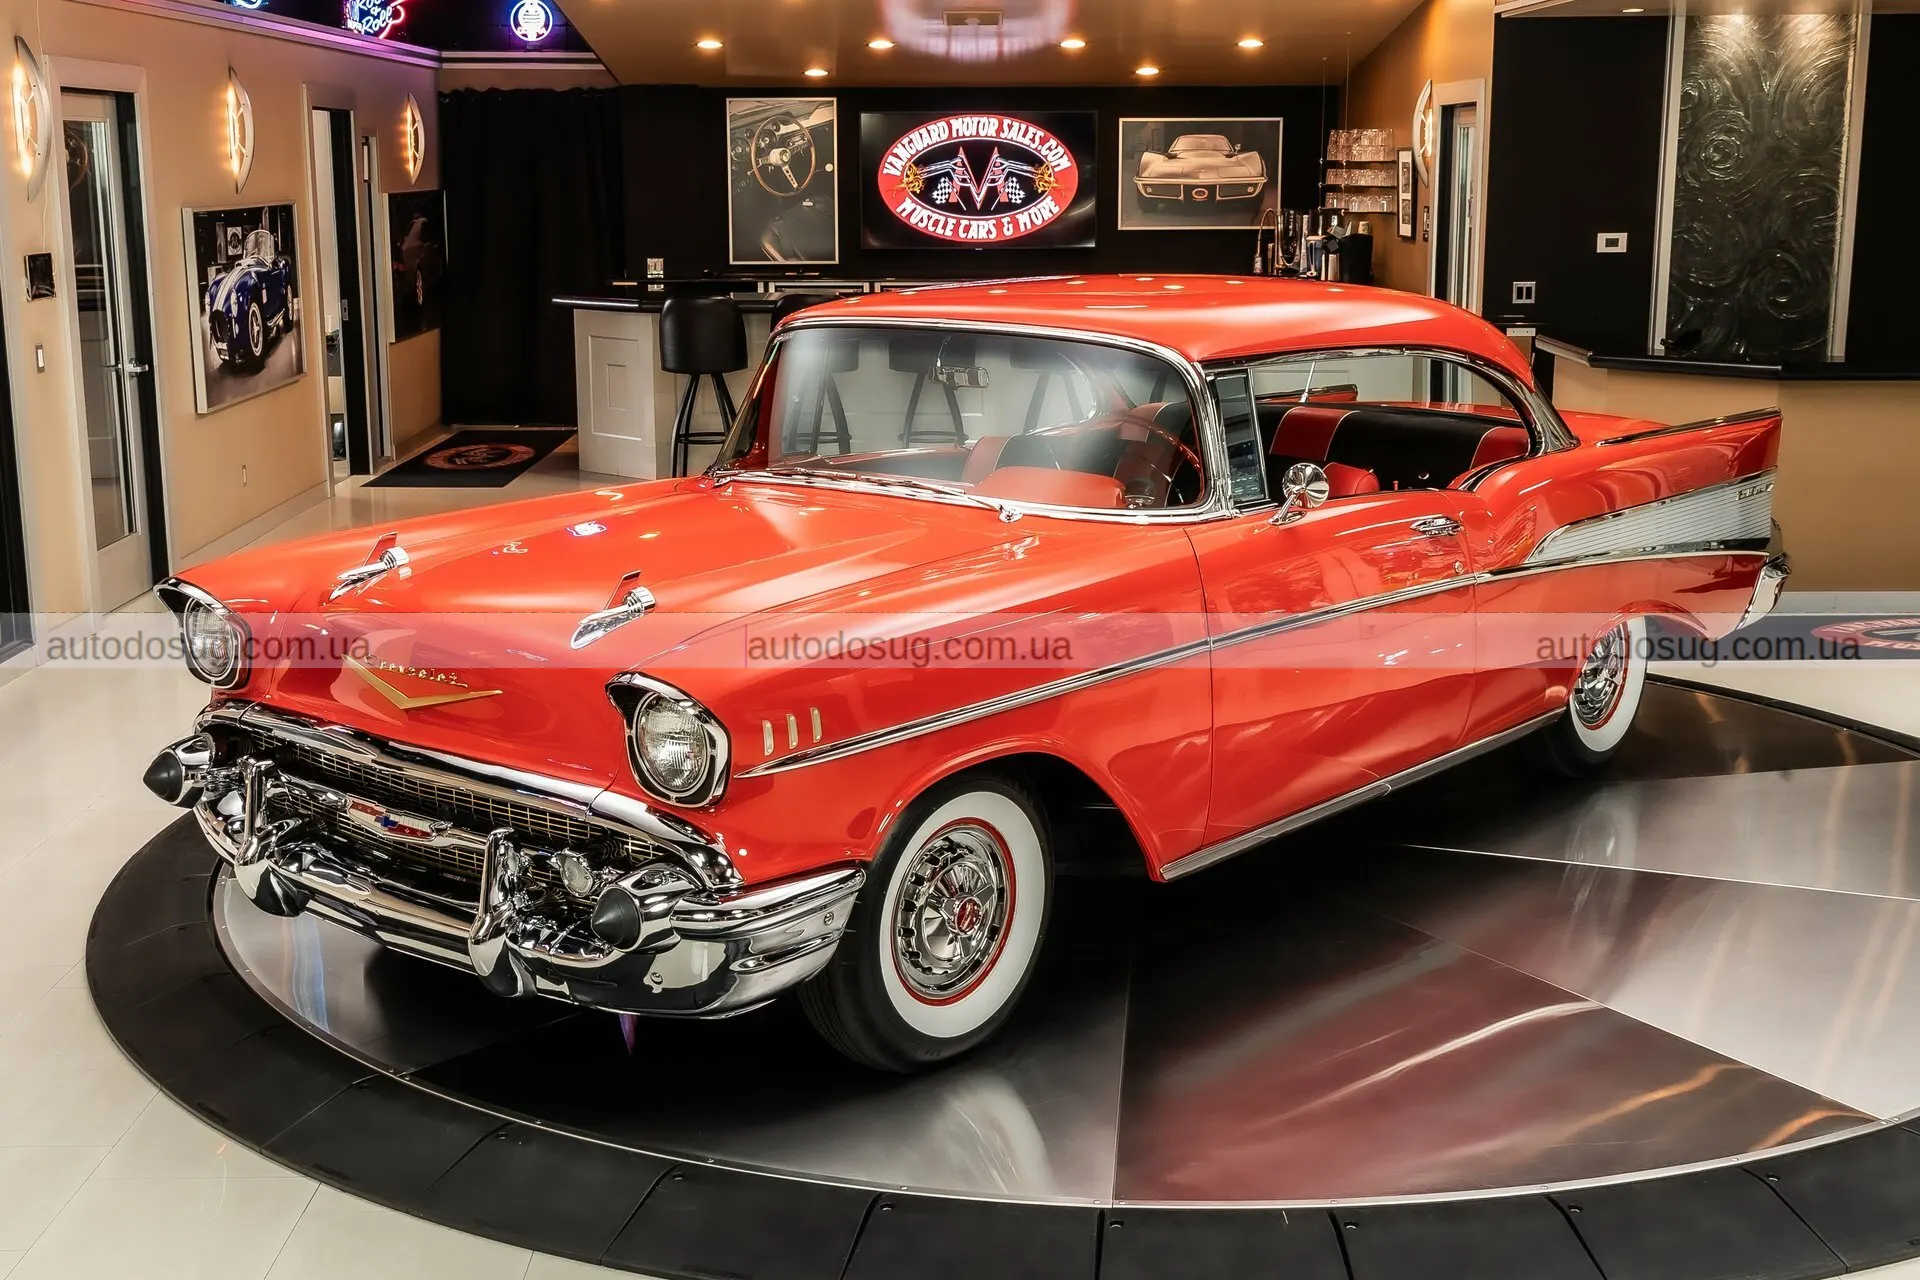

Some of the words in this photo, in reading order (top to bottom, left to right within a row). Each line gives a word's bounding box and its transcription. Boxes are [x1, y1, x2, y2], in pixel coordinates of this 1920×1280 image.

[361, 5, 393, 35] Roll
[882, 120, 949, 177] VANGUARD
[949, 116, 999, 137] MOTOR
[1000, 118, 1072, 173] SALES.COM
[895, 197, 954, 237] MUSCLE
[958, 219, 997, 240] CARS
[1002, 217, 1014, 237] &
[1015, 196, 1060, 233] MORE
